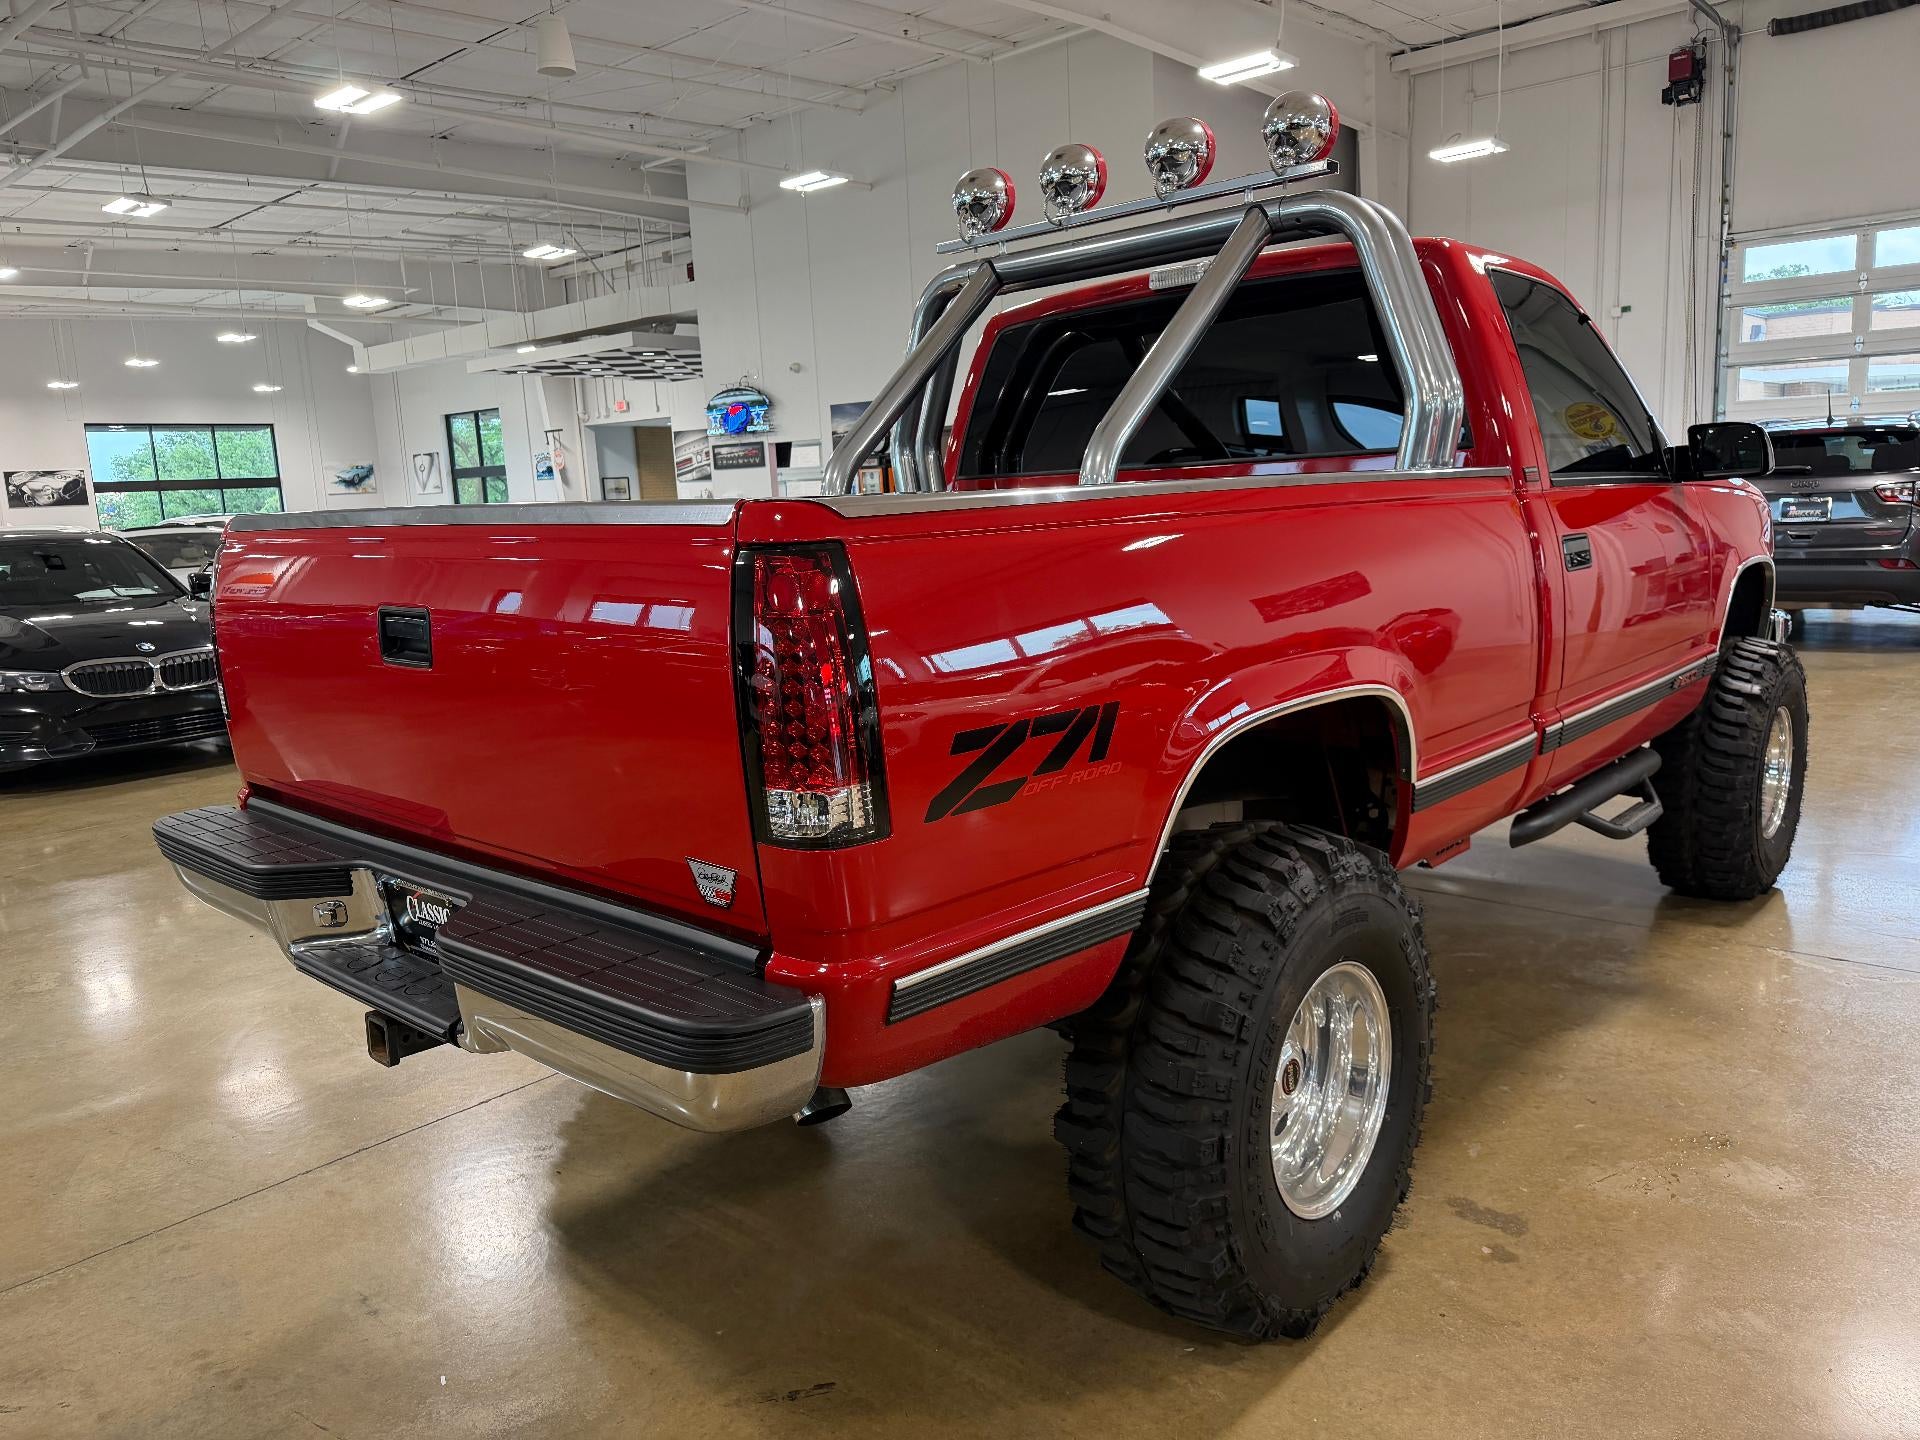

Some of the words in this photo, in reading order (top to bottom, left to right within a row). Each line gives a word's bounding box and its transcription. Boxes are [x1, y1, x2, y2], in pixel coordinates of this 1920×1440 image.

[924, 701, 1120, 824] Z71
[1023, 774, 1068, 796] OFF
[1069, 762, 1122, 785] ROAD
